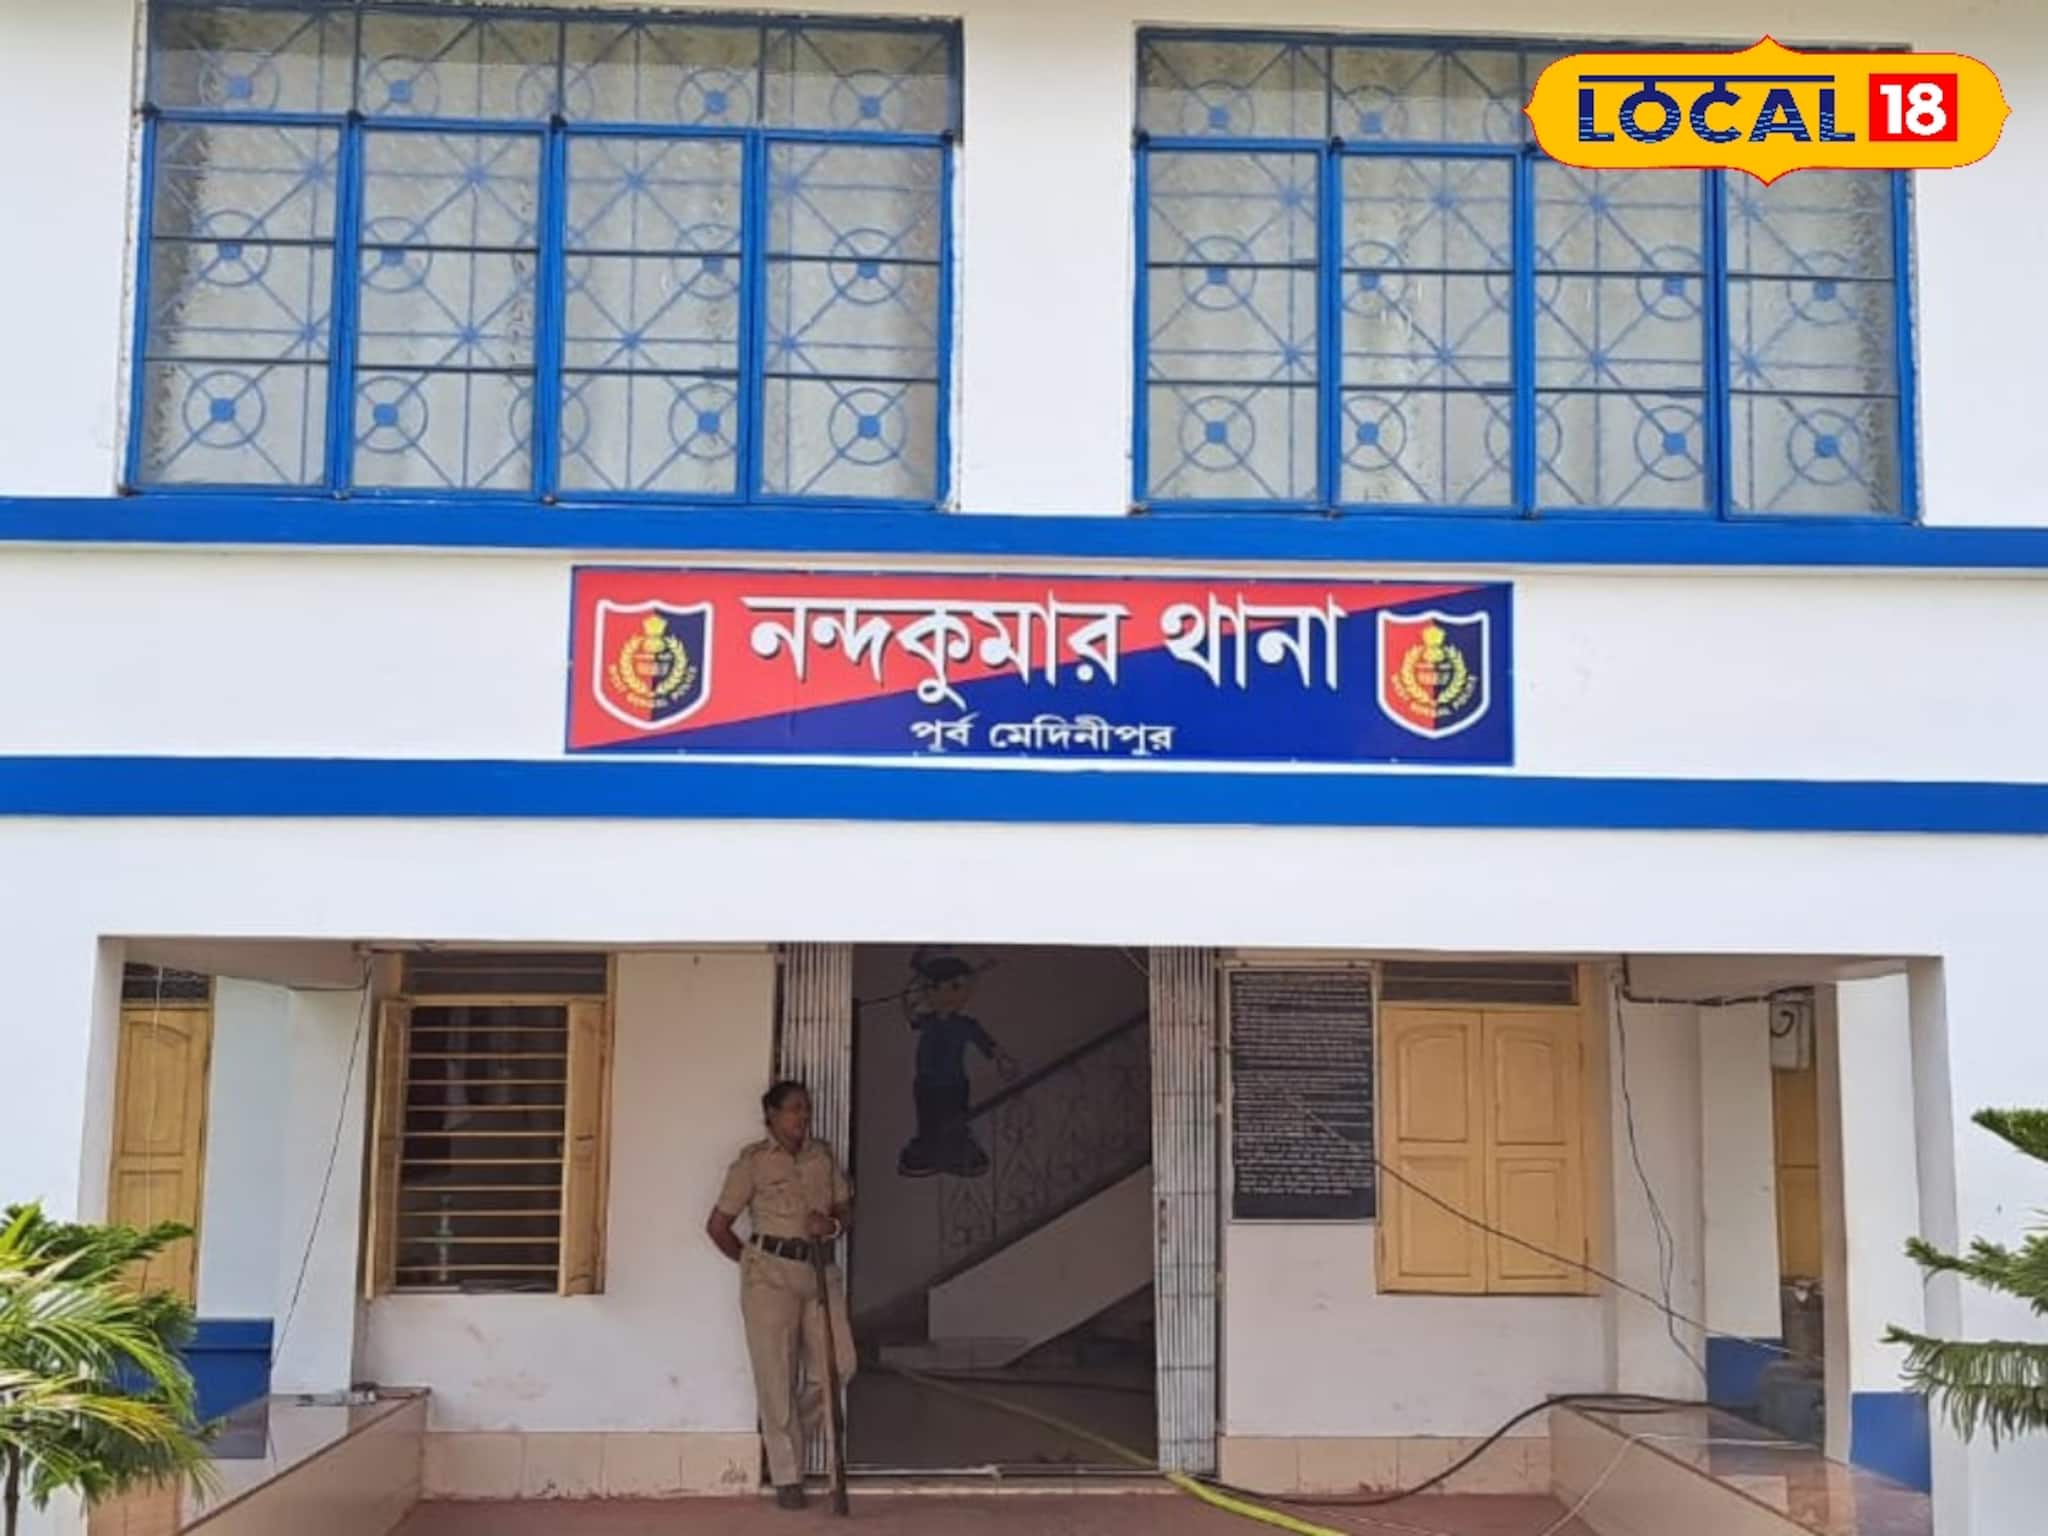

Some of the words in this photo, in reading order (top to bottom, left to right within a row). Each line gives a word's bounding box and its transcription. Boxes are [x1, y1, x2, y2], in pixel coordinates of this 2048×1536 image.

[741, 591, 1130, 709] নন্দকুমার
[1160, 592, 1347, 689] থানা
[911, 714, 976, 752] পূর্ব
[989, 715, 1173, 756] মেদিনীপুর
